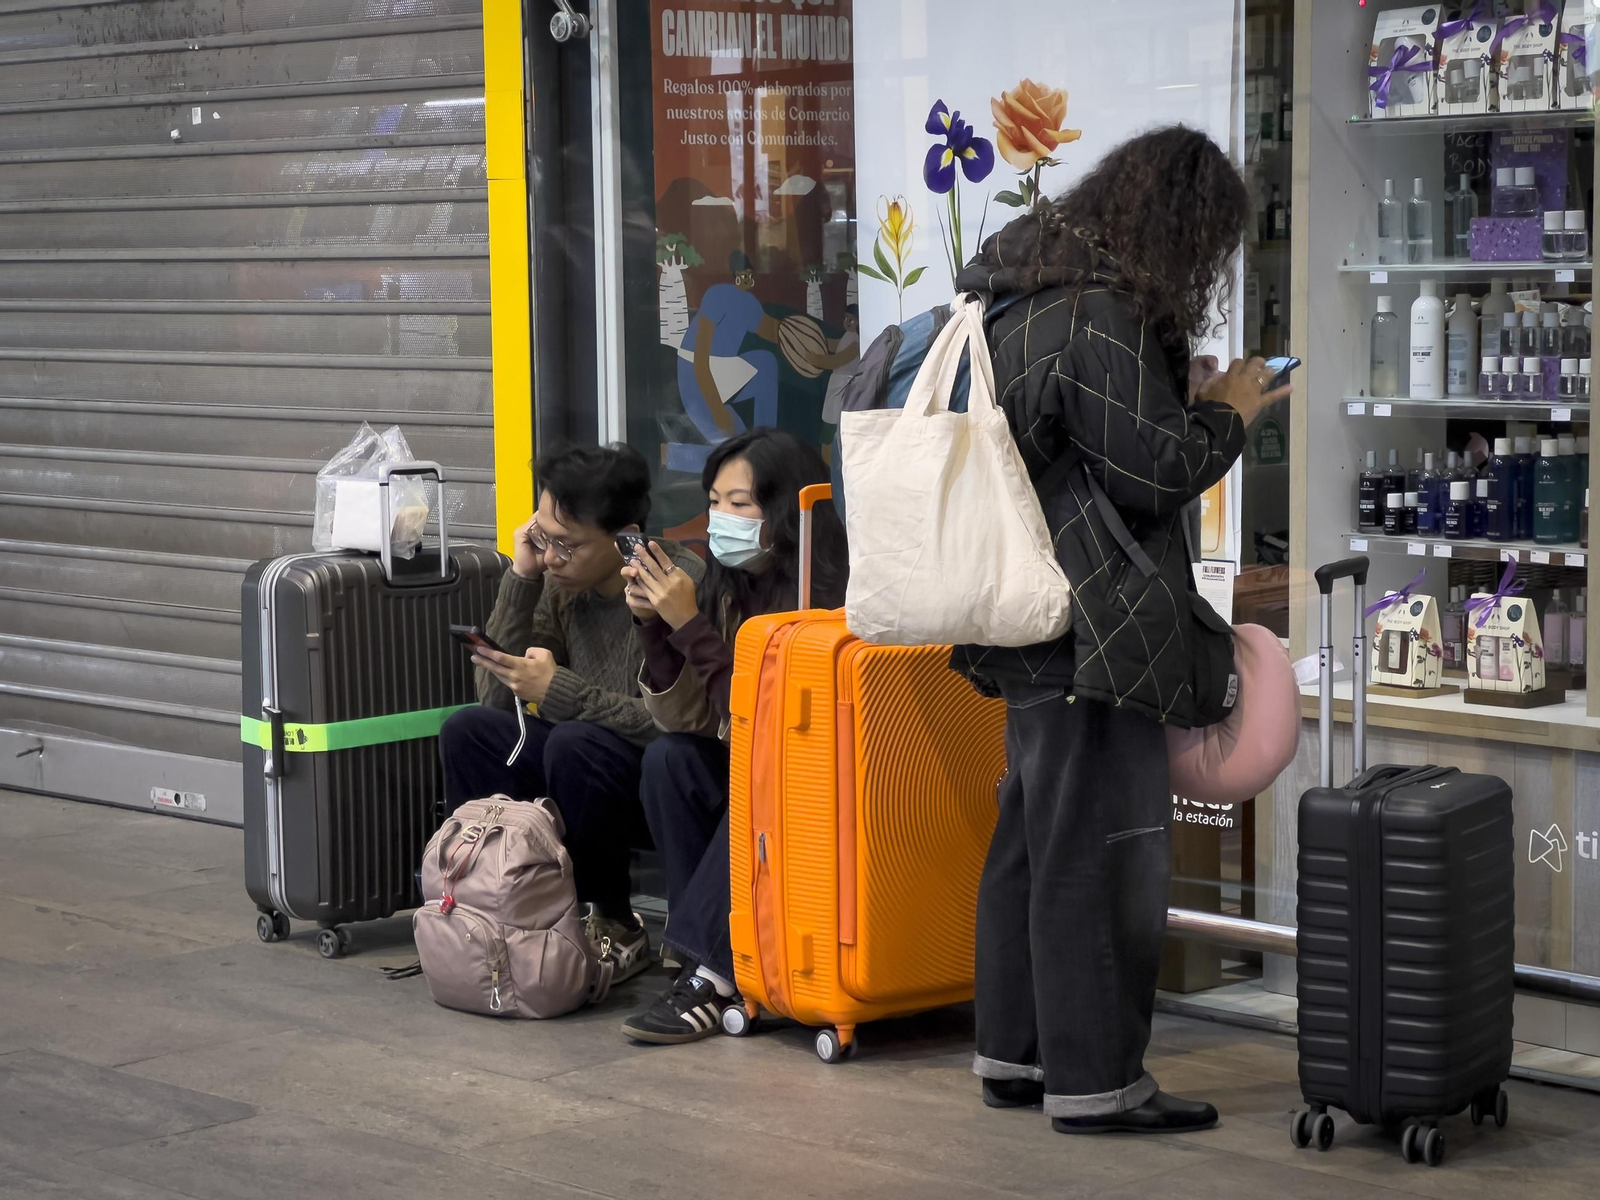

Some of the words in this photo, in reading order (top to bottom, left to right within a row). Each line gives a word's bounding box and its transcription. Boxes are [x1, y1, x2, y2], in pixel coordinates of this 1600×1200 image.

[662, 9, 752, 58] CAMBIAN
[756, 13, 777, 59] EL
[781, 14, 850, 61] MUNDO
[663, 78, 715, 96] Regalos
[718, 79, 754, 95] 100%
[758, 80, 828, 97] elaborados
[830, 86, 852, 101] por
[666, 107, 724, 120] nuestros
[727, 105, 768, 120] socios
[771, 105, 786, 120] de
[789, 106, 850, 121] Comercio
[680, 130, 717, 145] Justo
[720, 133, 744, 145] con
[747, 130, 838, 146] Comunidades.
[1173, 808, 1183, 821] la
[1186, 812, 1234, 828] estación
